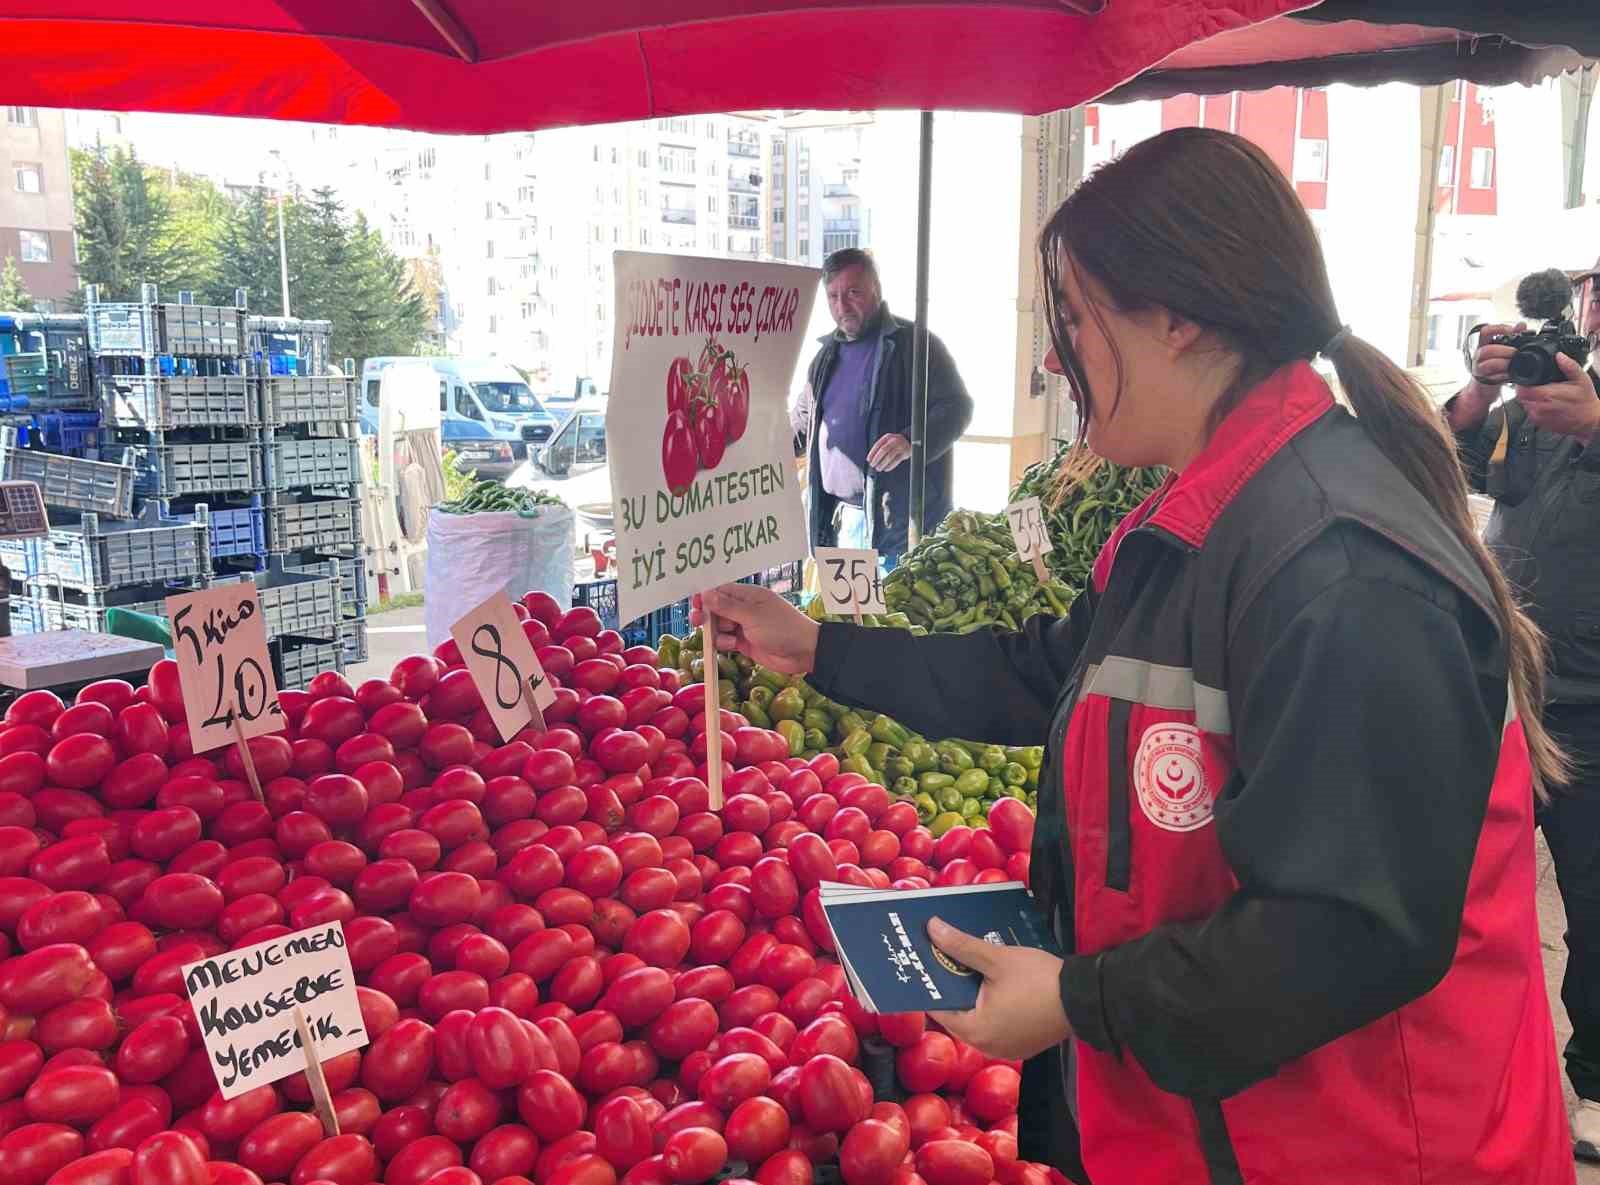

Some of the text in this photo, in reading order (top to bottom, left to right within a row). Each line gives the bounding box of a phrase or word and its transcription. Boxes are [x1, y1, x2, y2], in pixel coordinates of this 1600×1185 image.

[727, 281, 755, 334] SES
[754, 286, 799, 343] ÇIKAR
[621, 462, 785, 532] BU DOMATESTEN
[631, 515, 780, 590] İYİ SOS ÇIKAR
[173, 603, 203, 666] 5
[471, 624, 522, 709] 8
[187, 928, 344, 997] MENEMEN
